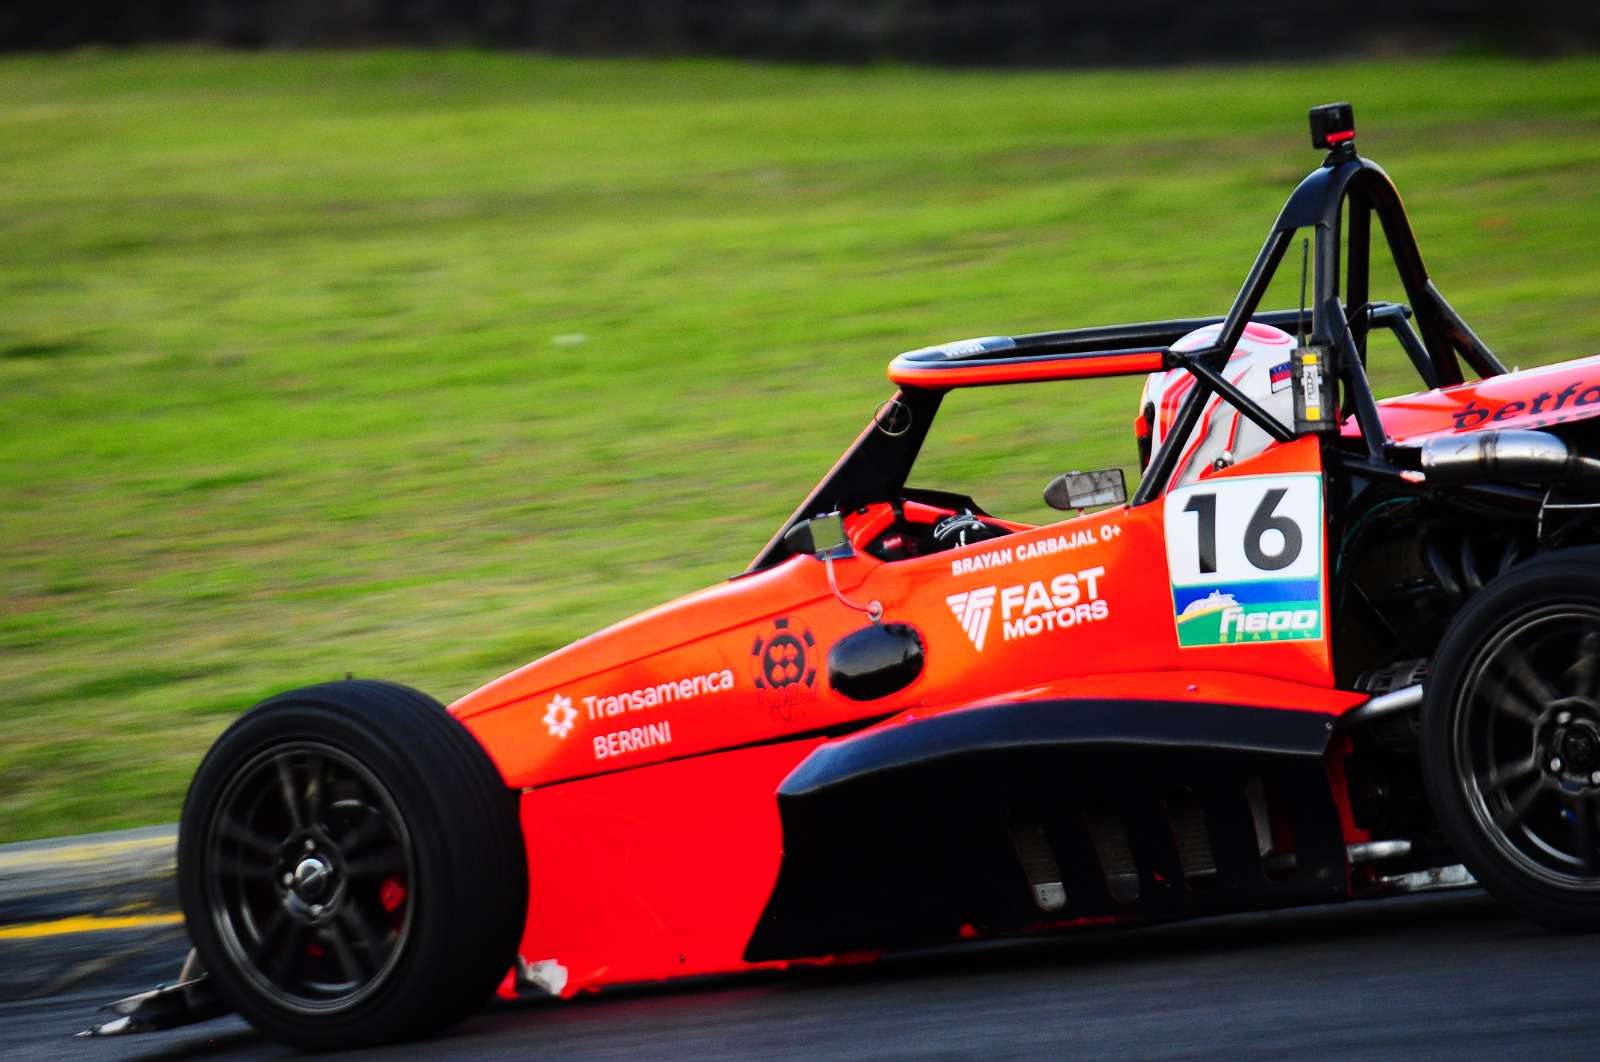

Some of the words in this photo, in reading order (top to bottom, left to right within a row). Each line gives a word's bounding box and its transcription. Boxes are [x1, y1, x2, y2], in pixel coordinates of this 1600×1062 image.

[951, 548, 1013, 577] BRAYAN
[1015, 529, 1098, 562] CARBAJAL
[1182, 487, 1303, 575] 16
[1000, 566, 1105, 620] FAST
[1002, 599, 1110, 641] MOTORS
[582, 668, 735, 721] Transamerica
[592, 720, 673, 760] BERRINI
